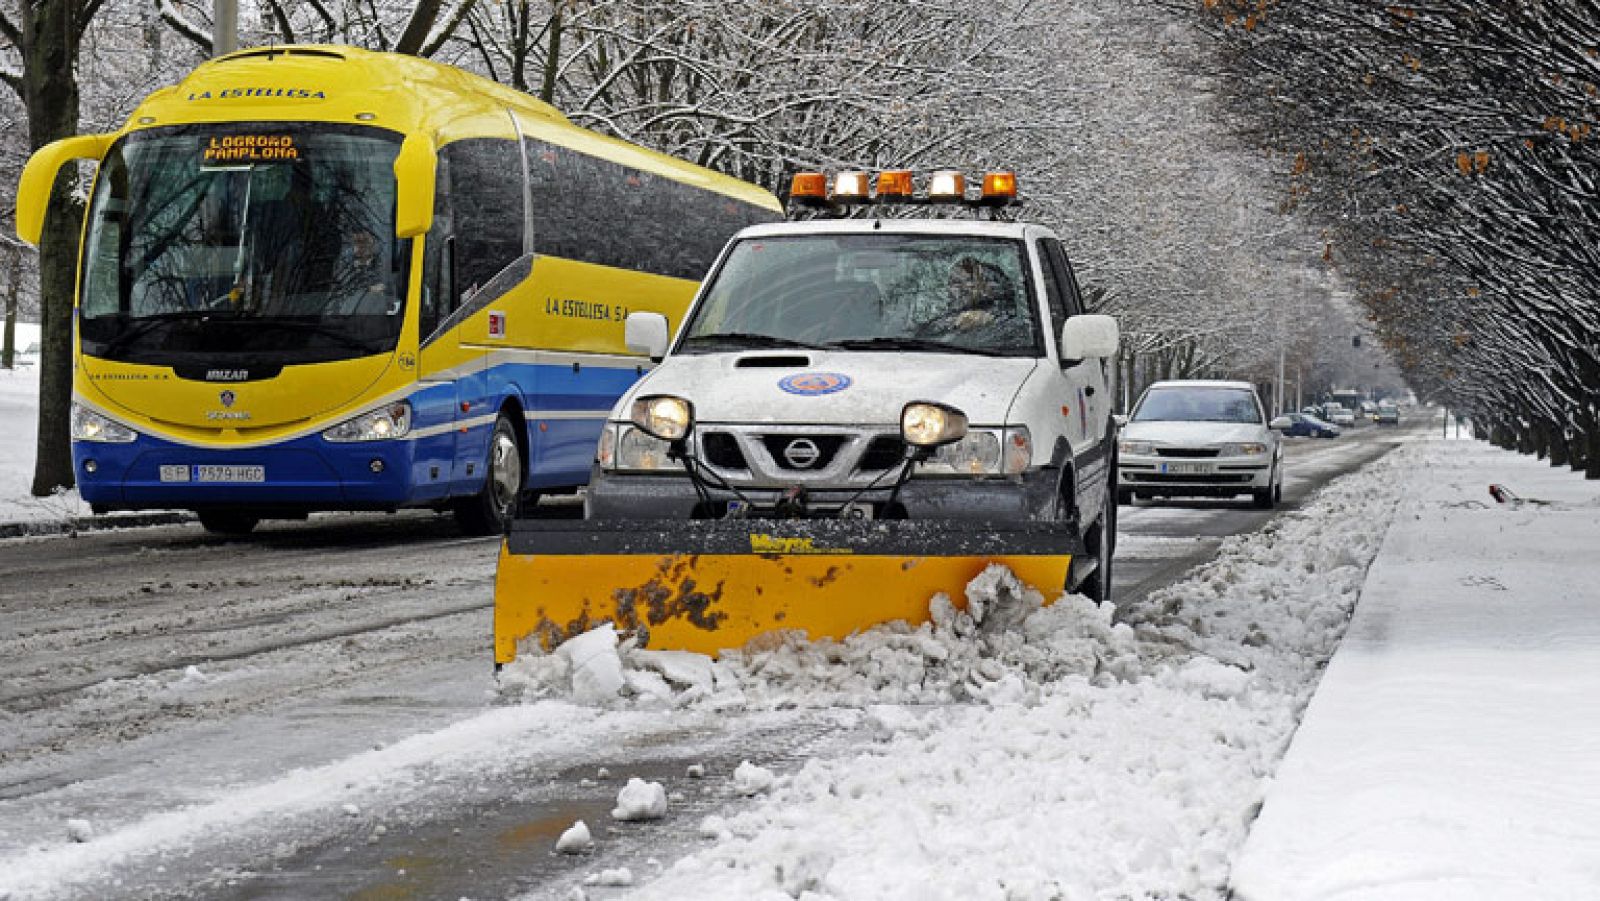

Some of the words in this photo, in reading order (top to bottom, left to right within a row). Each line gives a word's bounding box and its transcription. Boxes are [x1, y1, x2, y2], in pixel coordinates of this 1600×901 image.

[188, 91, 211, 100] LA
[219, 87, 325, 99] ESTELLESA
[204, 147, 299, 160] PAMPLONA
[545, 298, 560, 315] LA
[206, 369, 249, 381] IRIZAR
